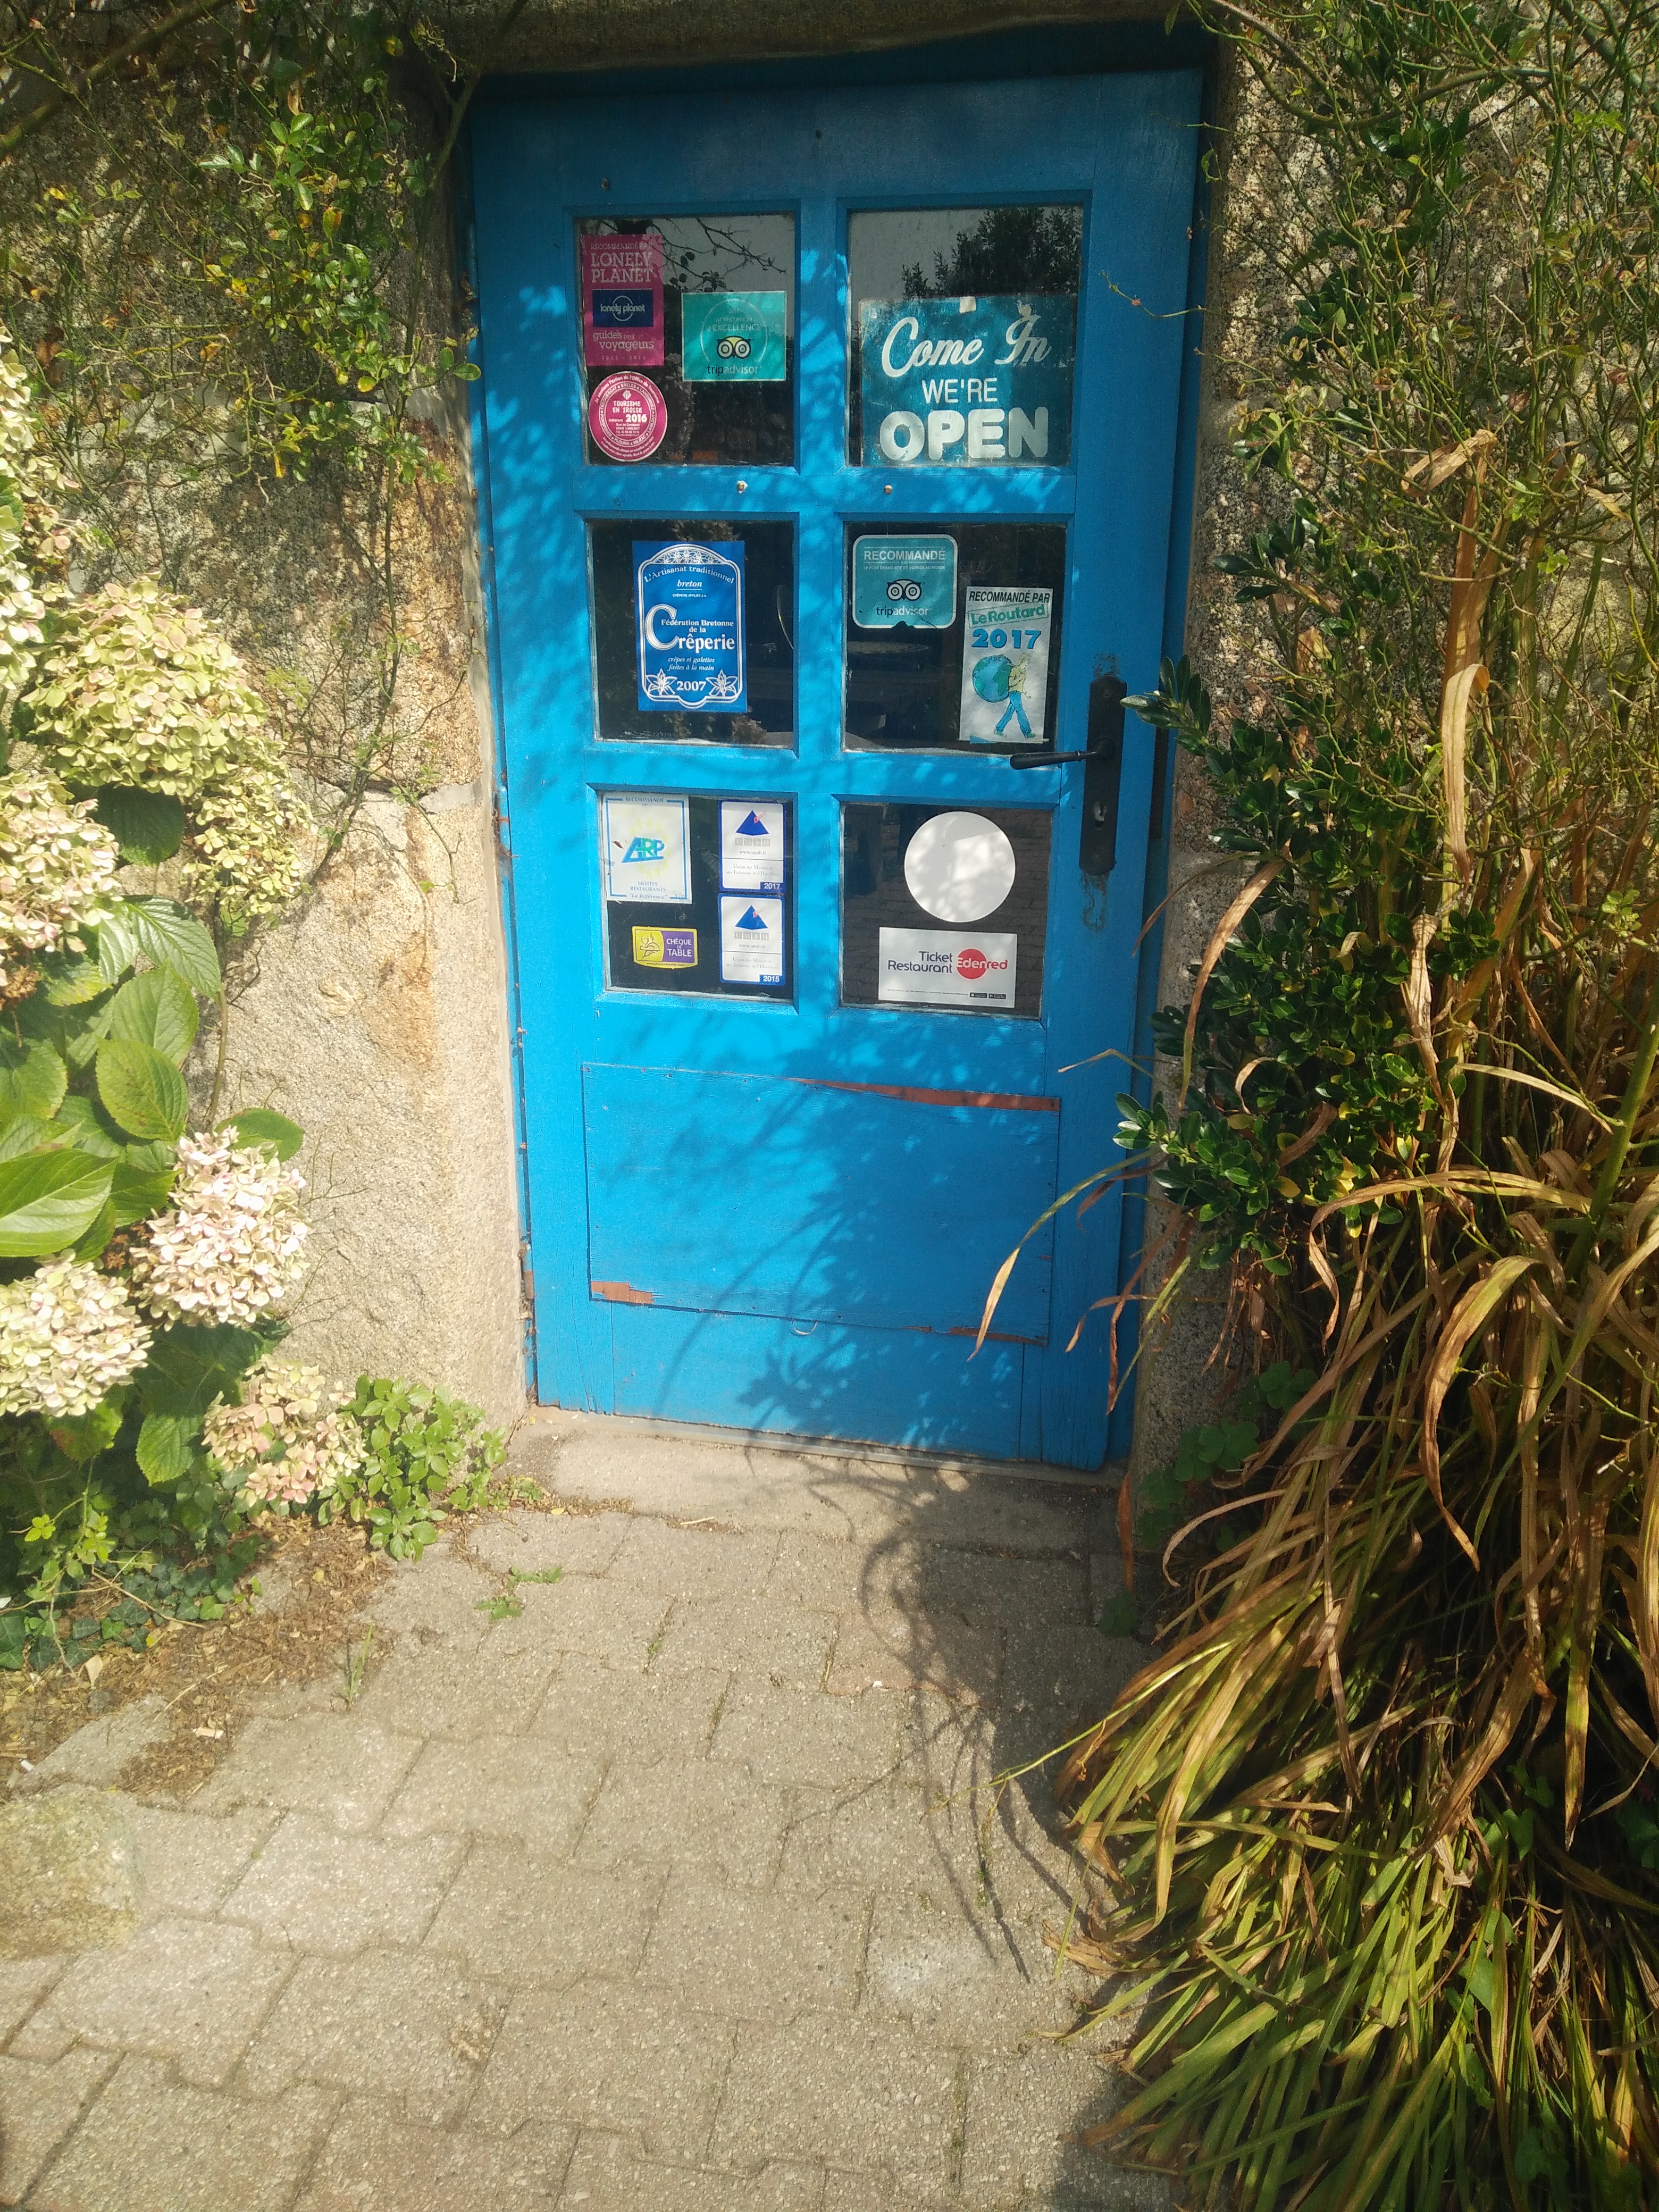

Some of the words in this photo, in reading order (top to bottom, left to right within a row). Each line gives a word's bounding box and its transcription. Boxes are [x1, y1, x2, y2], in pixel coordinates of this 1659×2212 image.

[591, 252, 652, 266] LONELY
[591, 268, 653, 283] PLANET
[600, 303, 621, 314] lonely
[623, 303, 645, 314] planet
[593, 331, 622, 341] guides
[599, 341, 654, 351] voyageurs
[882, 316, 985, 377] Come
[994, 314, 1052, 366] In
[707, 364, 758, 376] tripadvisor
[921, 378, 998, 404] WE'RE
[625, 414, 648, 422] 2016
[879, 407, 1049, 461] OPEN
[864, 548, 945, 560] RECOMMANDÉ
[644, 566, 686, 582] L'Artisanat
[689, 566, 734, 584] traditionnel
[969, 590, 1030, 602] RECOMMANDÉ
[1032, 593, 1050, 604] PAR
[876, 606, 929, 617] tripadvisor
[971, 613, 987, 625] Le
[988, 604, 1045, 622] Routard
[645, 604, 735, 654] Crêperie
[971, 628, 1042, 649] 2017
[676, 681, 707, 691] 2007
[622, 837, 665, 864] ARP
[666, 936, 692, 945] CHÈQUE
[667, 949, 692, 957] TABLE
[919, 951, 953, 962] Ticket
[888, 960, 952, 974] Restaurant
[957, 957, 1008, 970] Edenred
